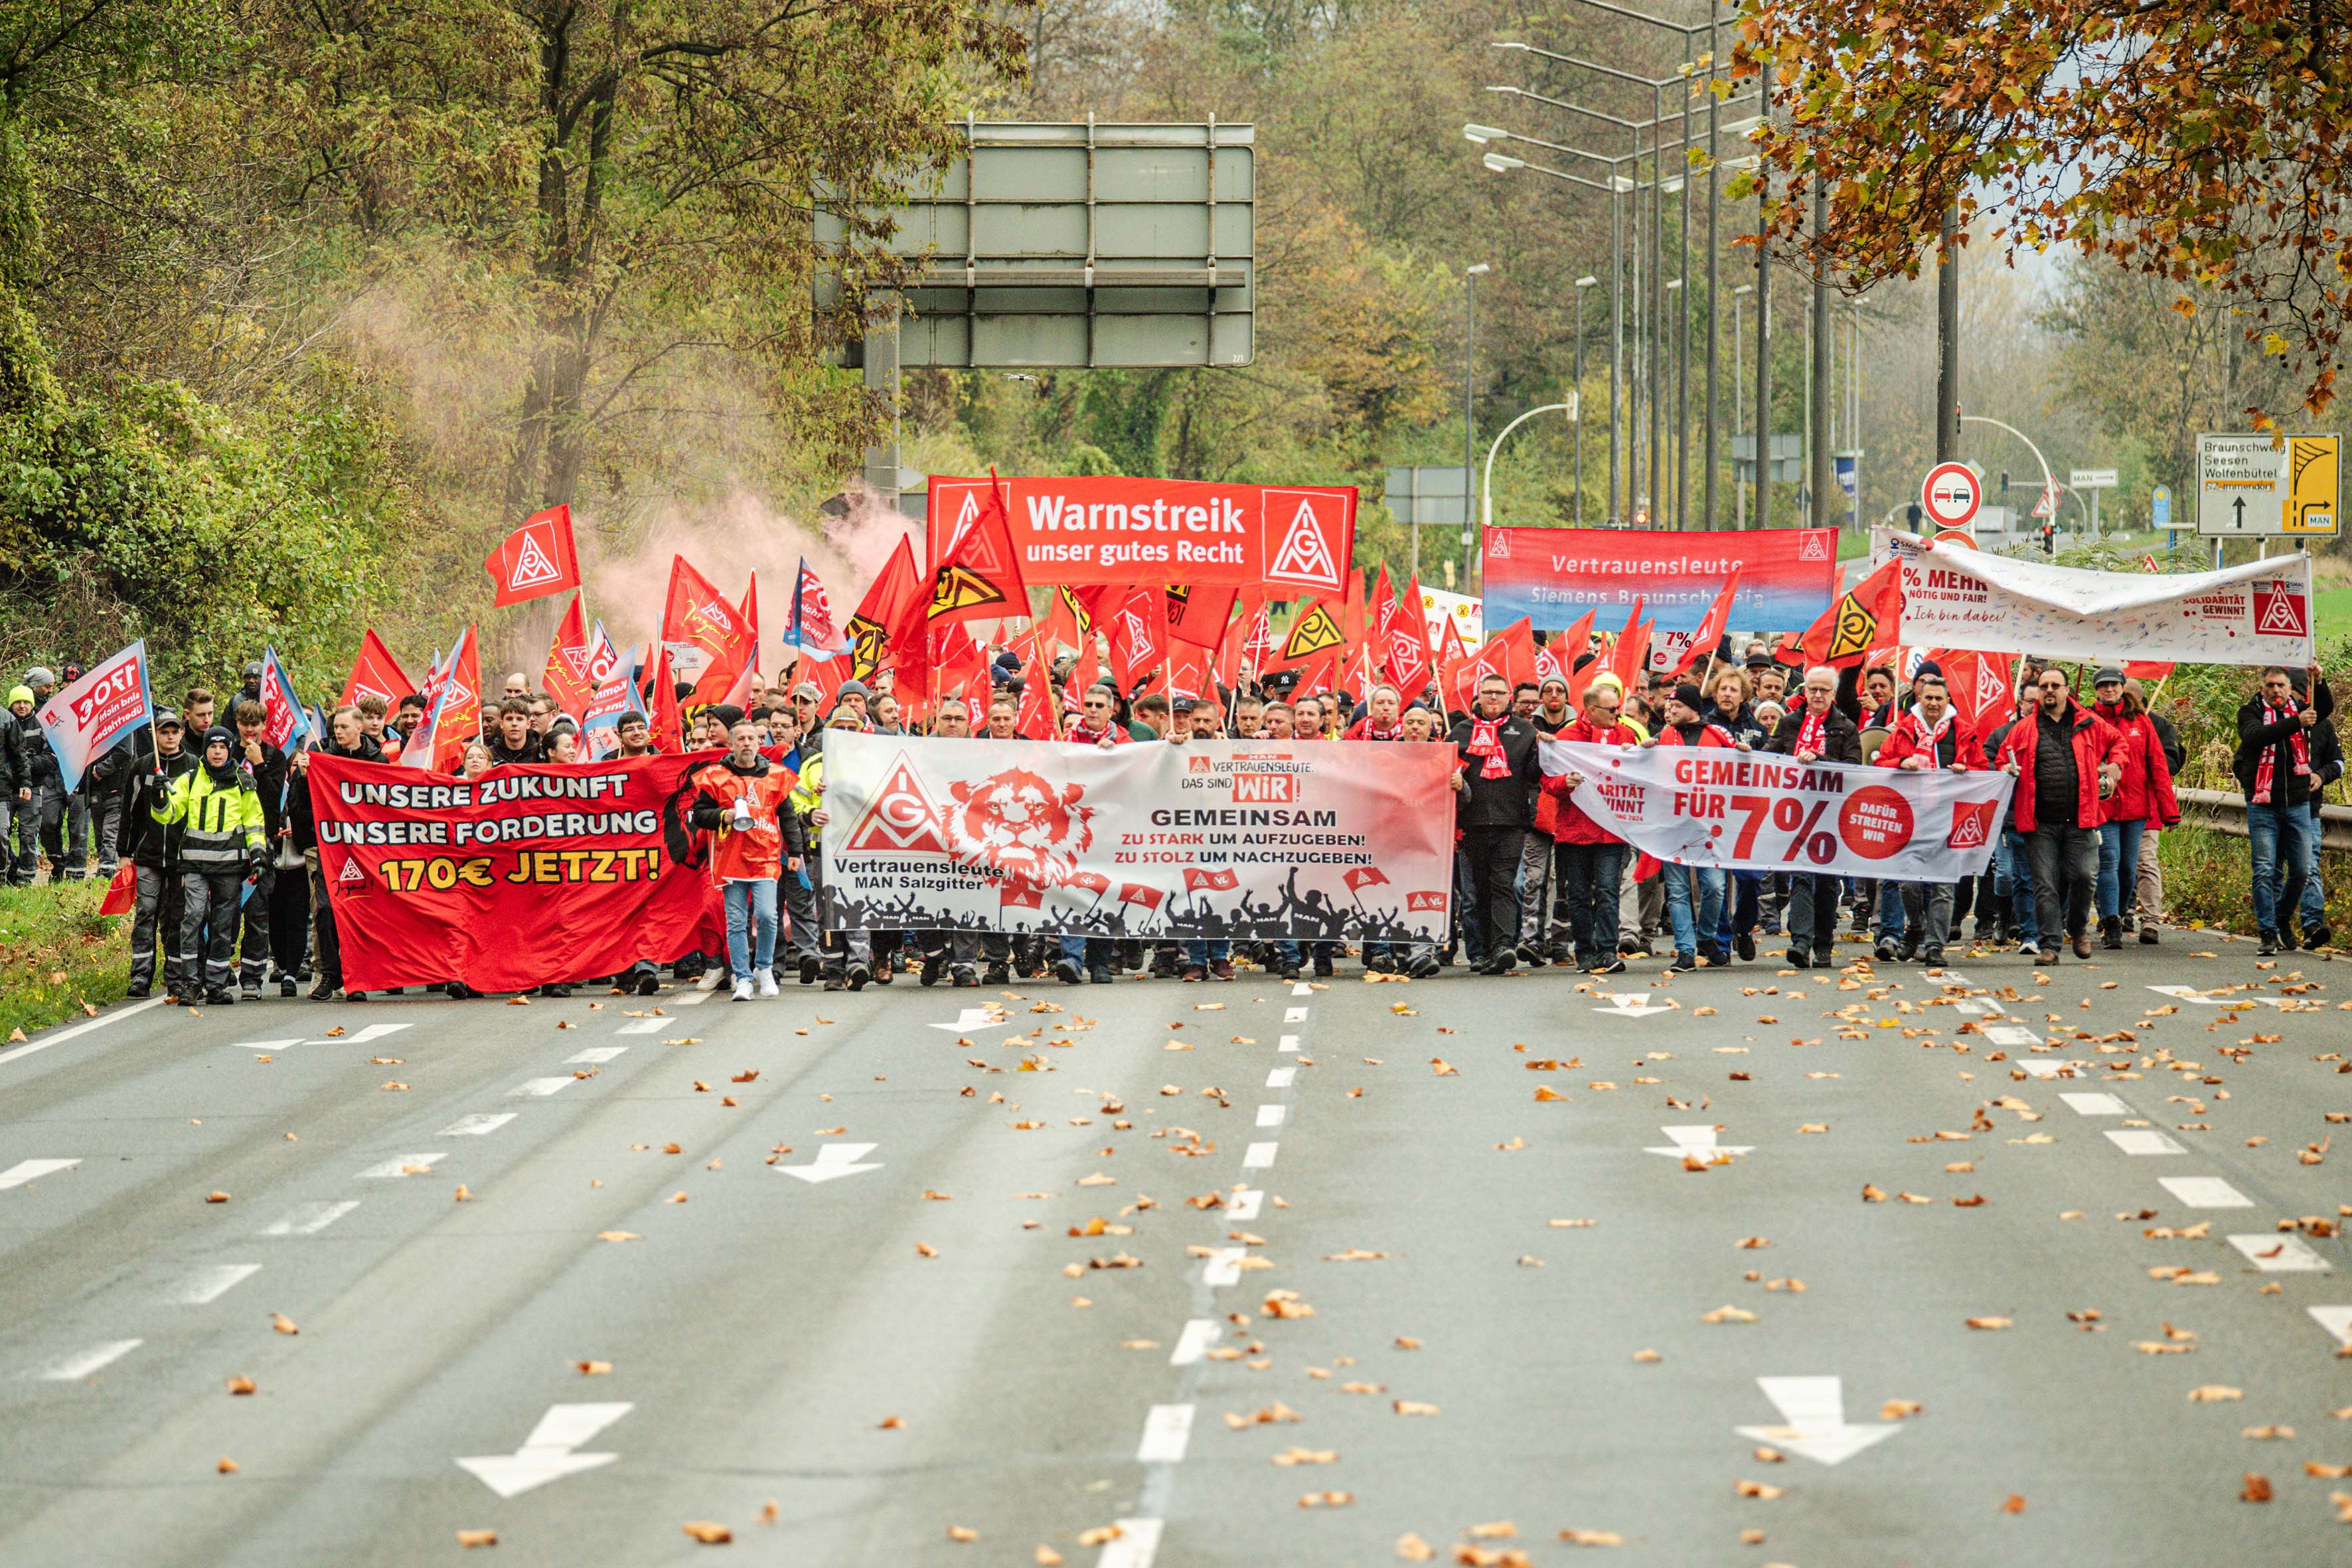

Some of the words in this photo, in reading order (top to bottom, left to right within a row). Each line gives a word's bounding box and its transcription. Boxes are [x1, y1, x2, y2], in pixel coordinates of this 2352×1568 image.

[2205, 441, 2286, 454] Braunschweg
[2205, 455, 2248, 465] Seesen
[2073, 473, 2093, 482] MAN
[2205, 468, 2278, 479] Wolfenbüttel
[1026, 495, 1245, 534] Warnstreik
[1027, 544, 1094, 562] unser
[1099, 541, 1169, 566] gutes
[1176, 541, 1244, 564] Recht
[1551, 555, 1743, 575] Vertrauensleute
[1928, 569, 1989, 592] MEHR
[1530, 587, 1607, 604] Siemens
[1618, 589, 1764, 609] Braunscheig
[1909, 588, 1938, 600] NÖTIG
[1940, 591, 1960, 601] UND
[1962, 593, 1987, 603] FAIR!
[2182, 593, 2246, 605] SOLIDARITÄT
[1913, 605, 1936, 620] Ich
[1938, 608, 1960, 621] bin
[1962, 608, 2007, 622] dabei!
[2203, 605, 2246, 615] GEWINNT
[1666, 631, 1691, 648] 7%
[1182, 777, 1204, 789] DAS
[1207, 777, 1233, 789] SIND
[1675, 759, 1844, 794] GEMEINSAM
[341, 781, 471, 809] UNSERE
[480, 773, 629, 805] ZUKUNFT
[1597, 783, 1645, 799] ARITÄT
[1150, 809, 1337, 827] GEMEINSAM
[1859, 802, 1897, 819] DAFÜR
[319, 819, 447, 846] UNSERE
[455, 809, 657, 846] FORDERUNG
[1674, 787, 1726, 819] FÜR
[1729, 795, 1838, 866] 7%
[1849, 814, 1903, 834] STREITEN
[1121, 834, 1144, 845] ZU
[1149, 833, 1204, 845] STARK
[1210, 834, 1237, 844] UM
[1242, 833, 1366, 846] AUFZUGEBEN!
[1862, 828, 1885, 844] WIR
[1115, 852, 1137, 864] ZU
[1142, 852, 1195, 864] STOLZ
[1200, 852, 1228, 863] UM
[1233, 851, 1372, 864] NACHZUGEBEN!
[378, 856, 496, 892] 170€
[507, 847, 662, 885] JETZT!
[834, 858, 1004, 878] Vertrauensleute
[855, 876, 893, 889] MAN
[900, 876, 984, 892] Salzgitter
[1293, 913, 1320, 923] MAN
